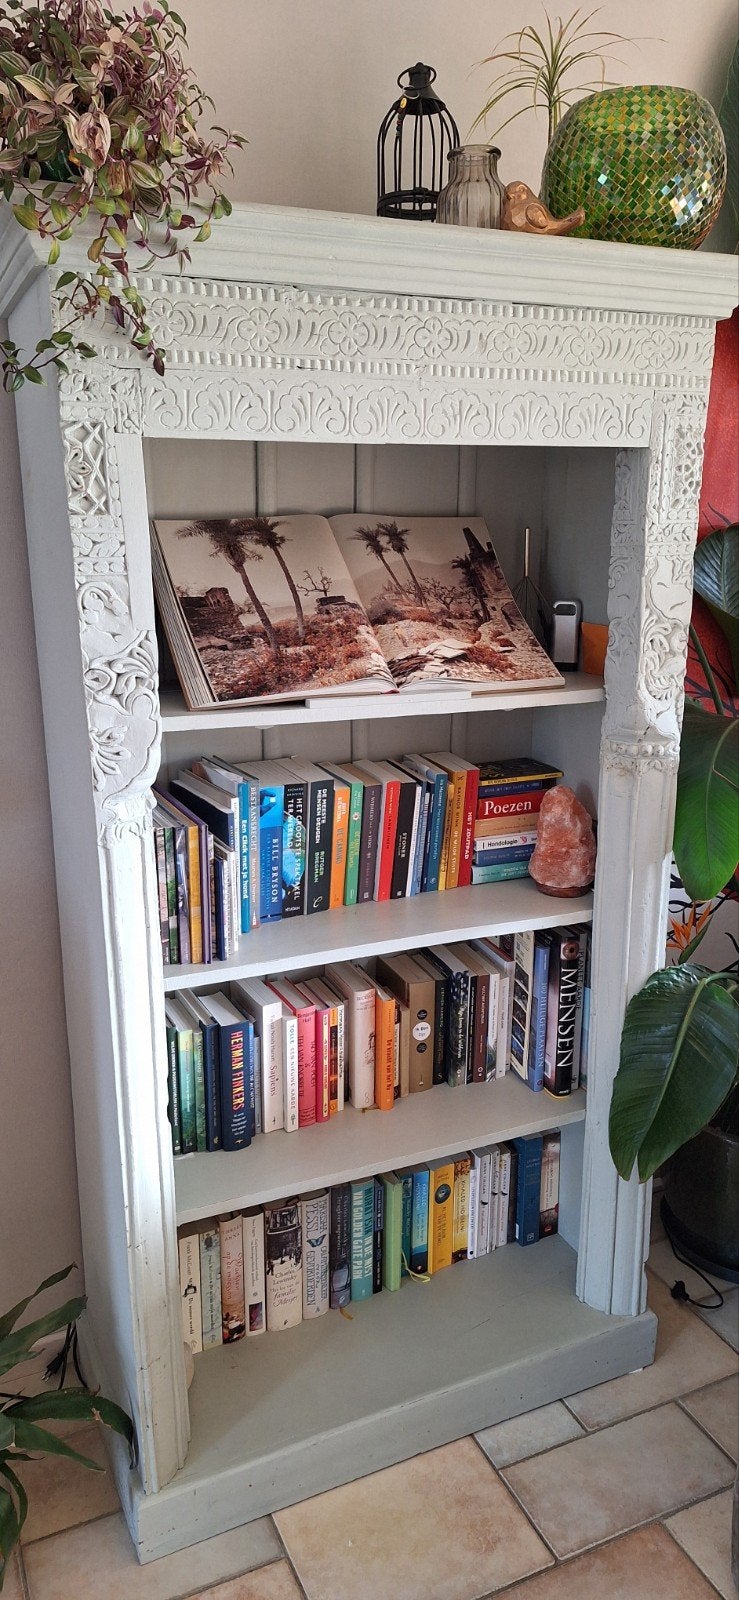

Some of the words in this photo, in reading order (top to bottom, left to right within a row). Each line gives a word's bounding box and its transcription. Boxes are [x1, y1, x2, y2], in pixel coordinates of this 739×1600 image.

[322, 789, 327, 799] DE
[484, 800, 532, 816] Poezen
[464, 828, 472, 860] ZOUTPAD
[241, 872, 248, 880] je
[294, 858, 302, 900] SPEKTAKEL
[539, 996, 547, 1027] HEILIGE
[556, 968, 578, 1067] MENSEN
[231, 1031, 243, 1069] HERMAN
[538, 1028, 546, 1067] PLAATSEN
[232, 1071, 245, 1110] FINKERS
[268, 1065, 279, 1097] Sapiens
[353, 1191, 363, 1206] VAN
[364, 1187, 372, 1216] MURAT
[306, 1203, 318, 1239] PESSL
[353, 1207, 363, 1237] GOLDEN
[353, 1240, 363, 1259] GATE
[365, 1236, 372, 1246] IN
[365, 1247, 372, 1257] DE
[353, 1261, 363, 1280] PARK
